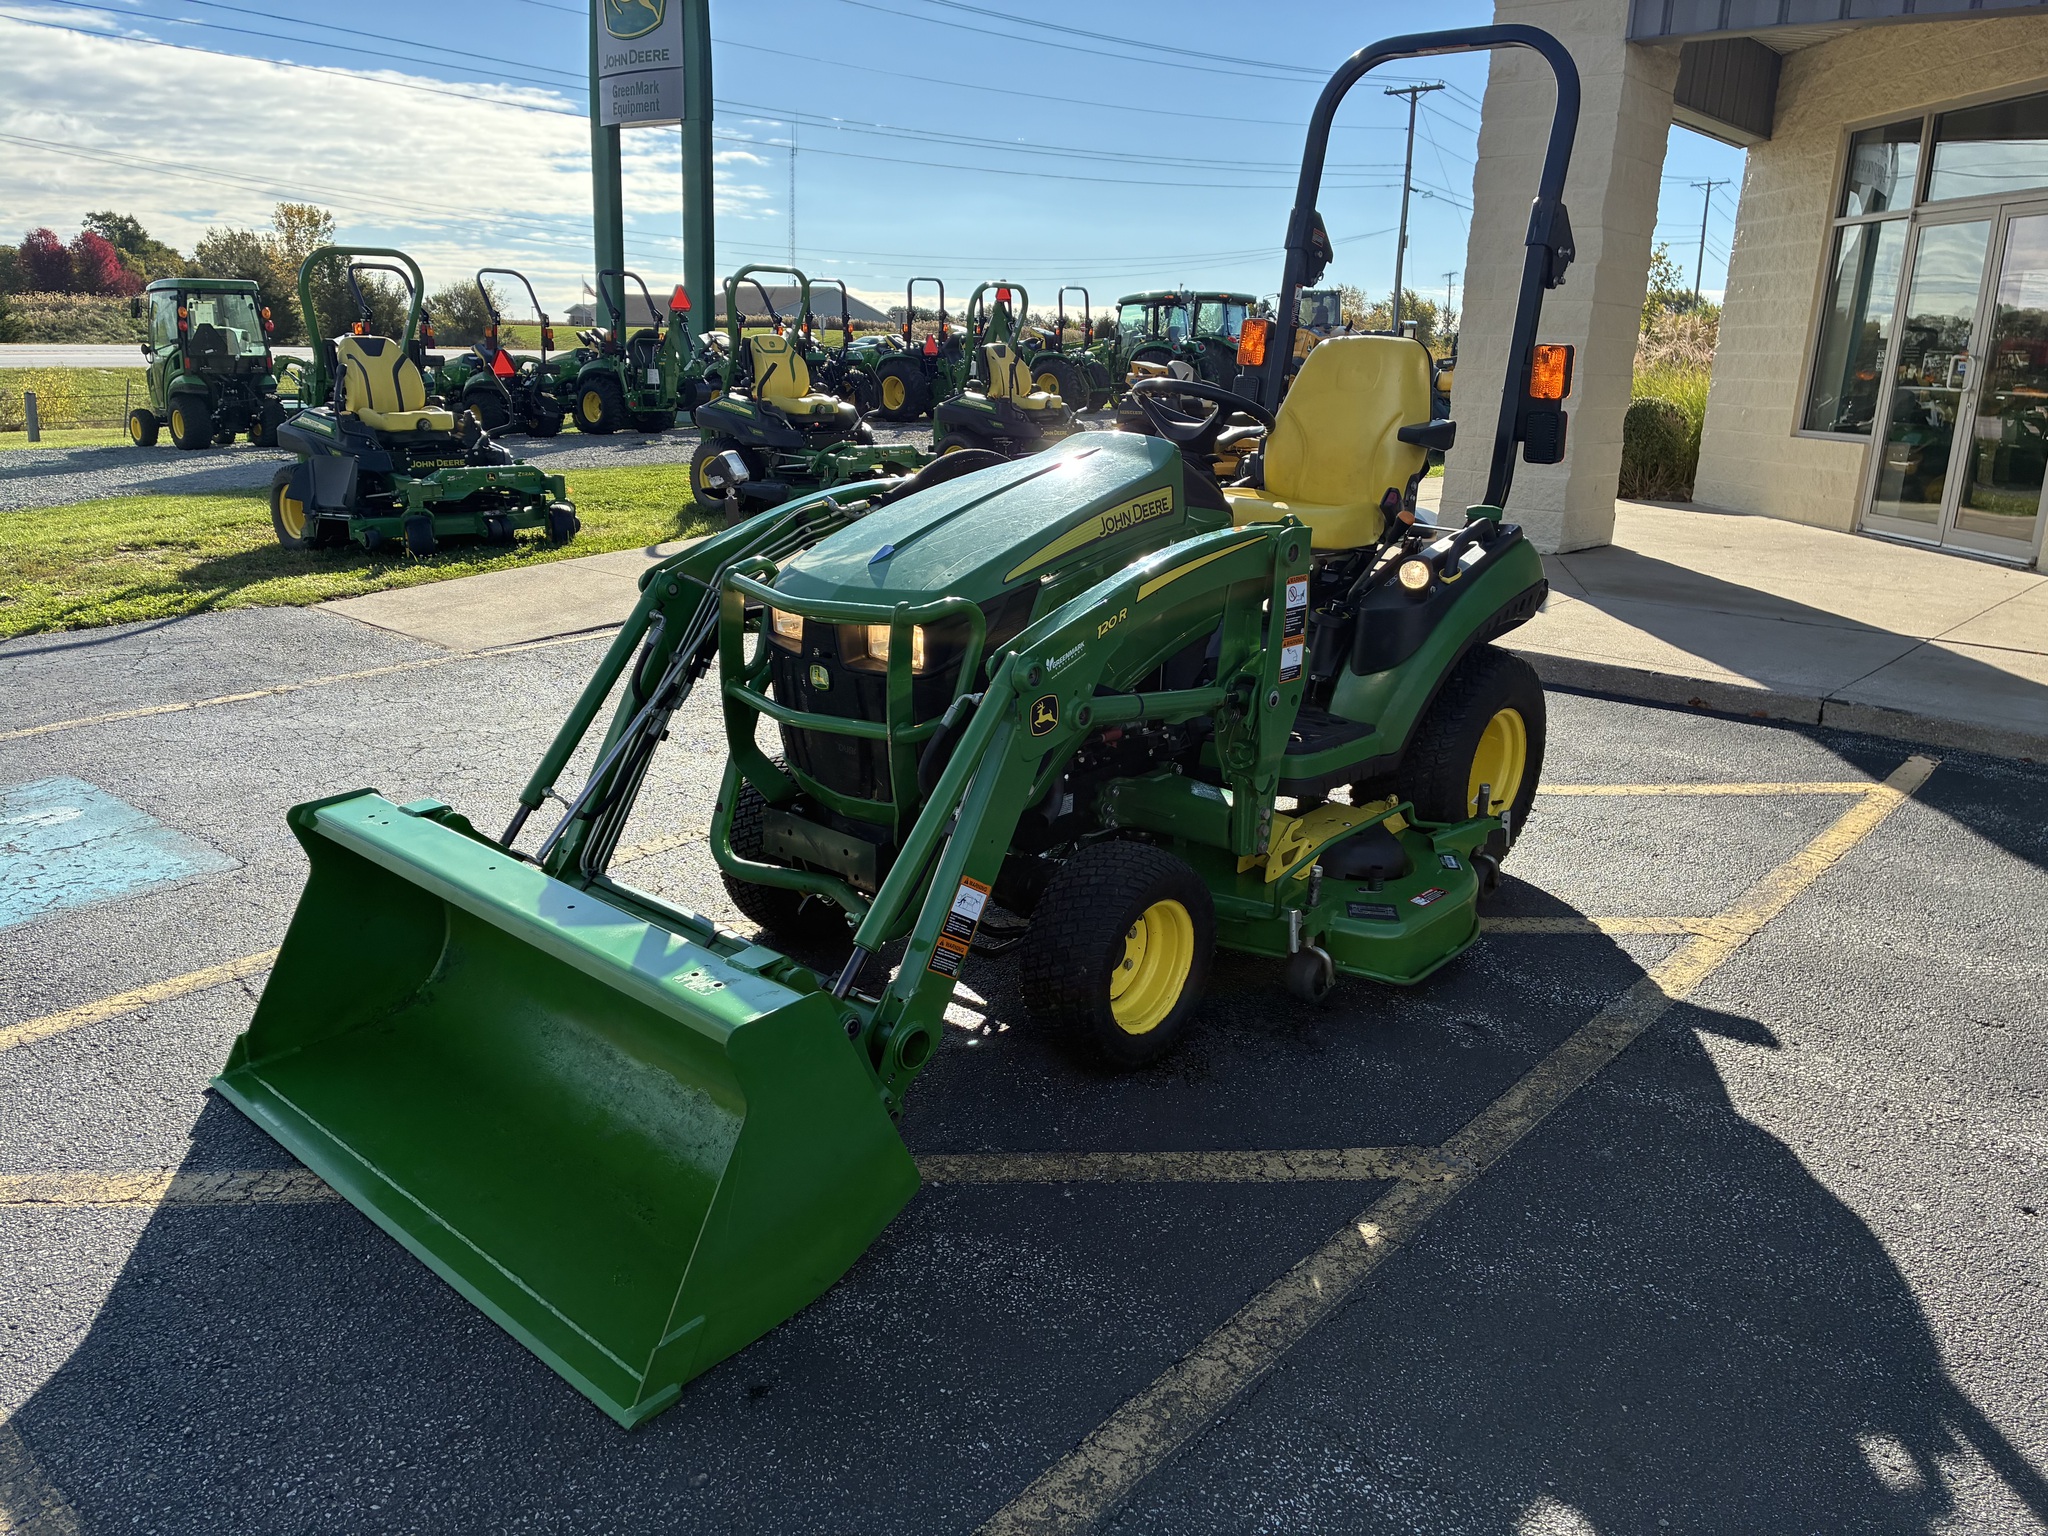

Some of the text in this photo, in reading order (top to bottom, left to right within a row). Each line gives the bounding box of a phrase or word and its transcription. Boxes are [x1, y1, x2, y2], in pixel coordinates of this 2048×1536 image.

[604, 49, 670, 69] JOHN DEERE
[612, 80, 660, 98] GreenMark
[612, 99, 660, 117] Equipment
[411, 460, 435, 468] JOHN
[1100, 497, 1169, 535] JOHN DEERE
[1053, 641, 1085, 669] GREENMARK
[968, 880, 988, 892] WARNING
[944, 942, 965, 954] WARNING
